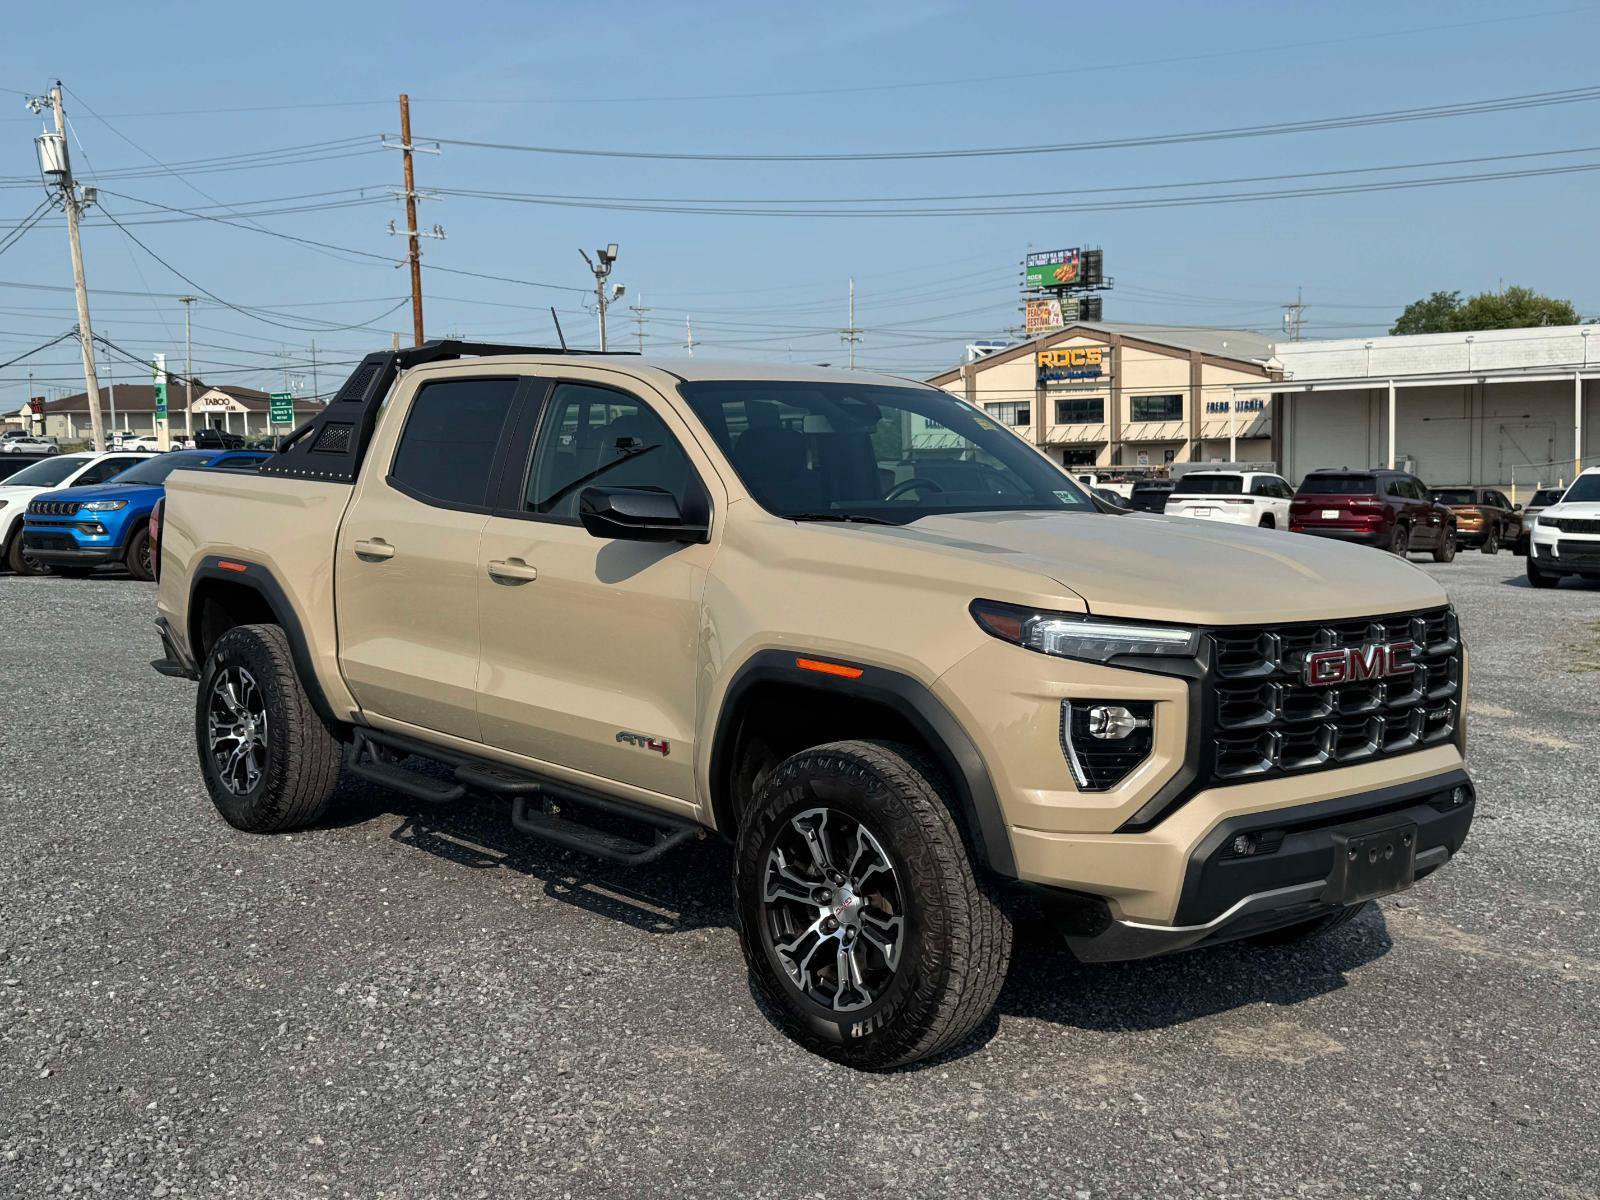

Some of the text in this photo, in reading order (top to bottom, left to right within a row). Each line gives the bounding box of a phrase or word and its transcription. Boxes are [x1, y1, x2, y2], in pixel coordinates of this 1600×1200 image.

[1037, 349, 1103, 368] ROCS
[204, 398, 230, 406] TABOO
[1303, 640, 1422, 687] GMC
[615, 729, 671, 757] AT4
[835, 896, 853, 916] GMC
